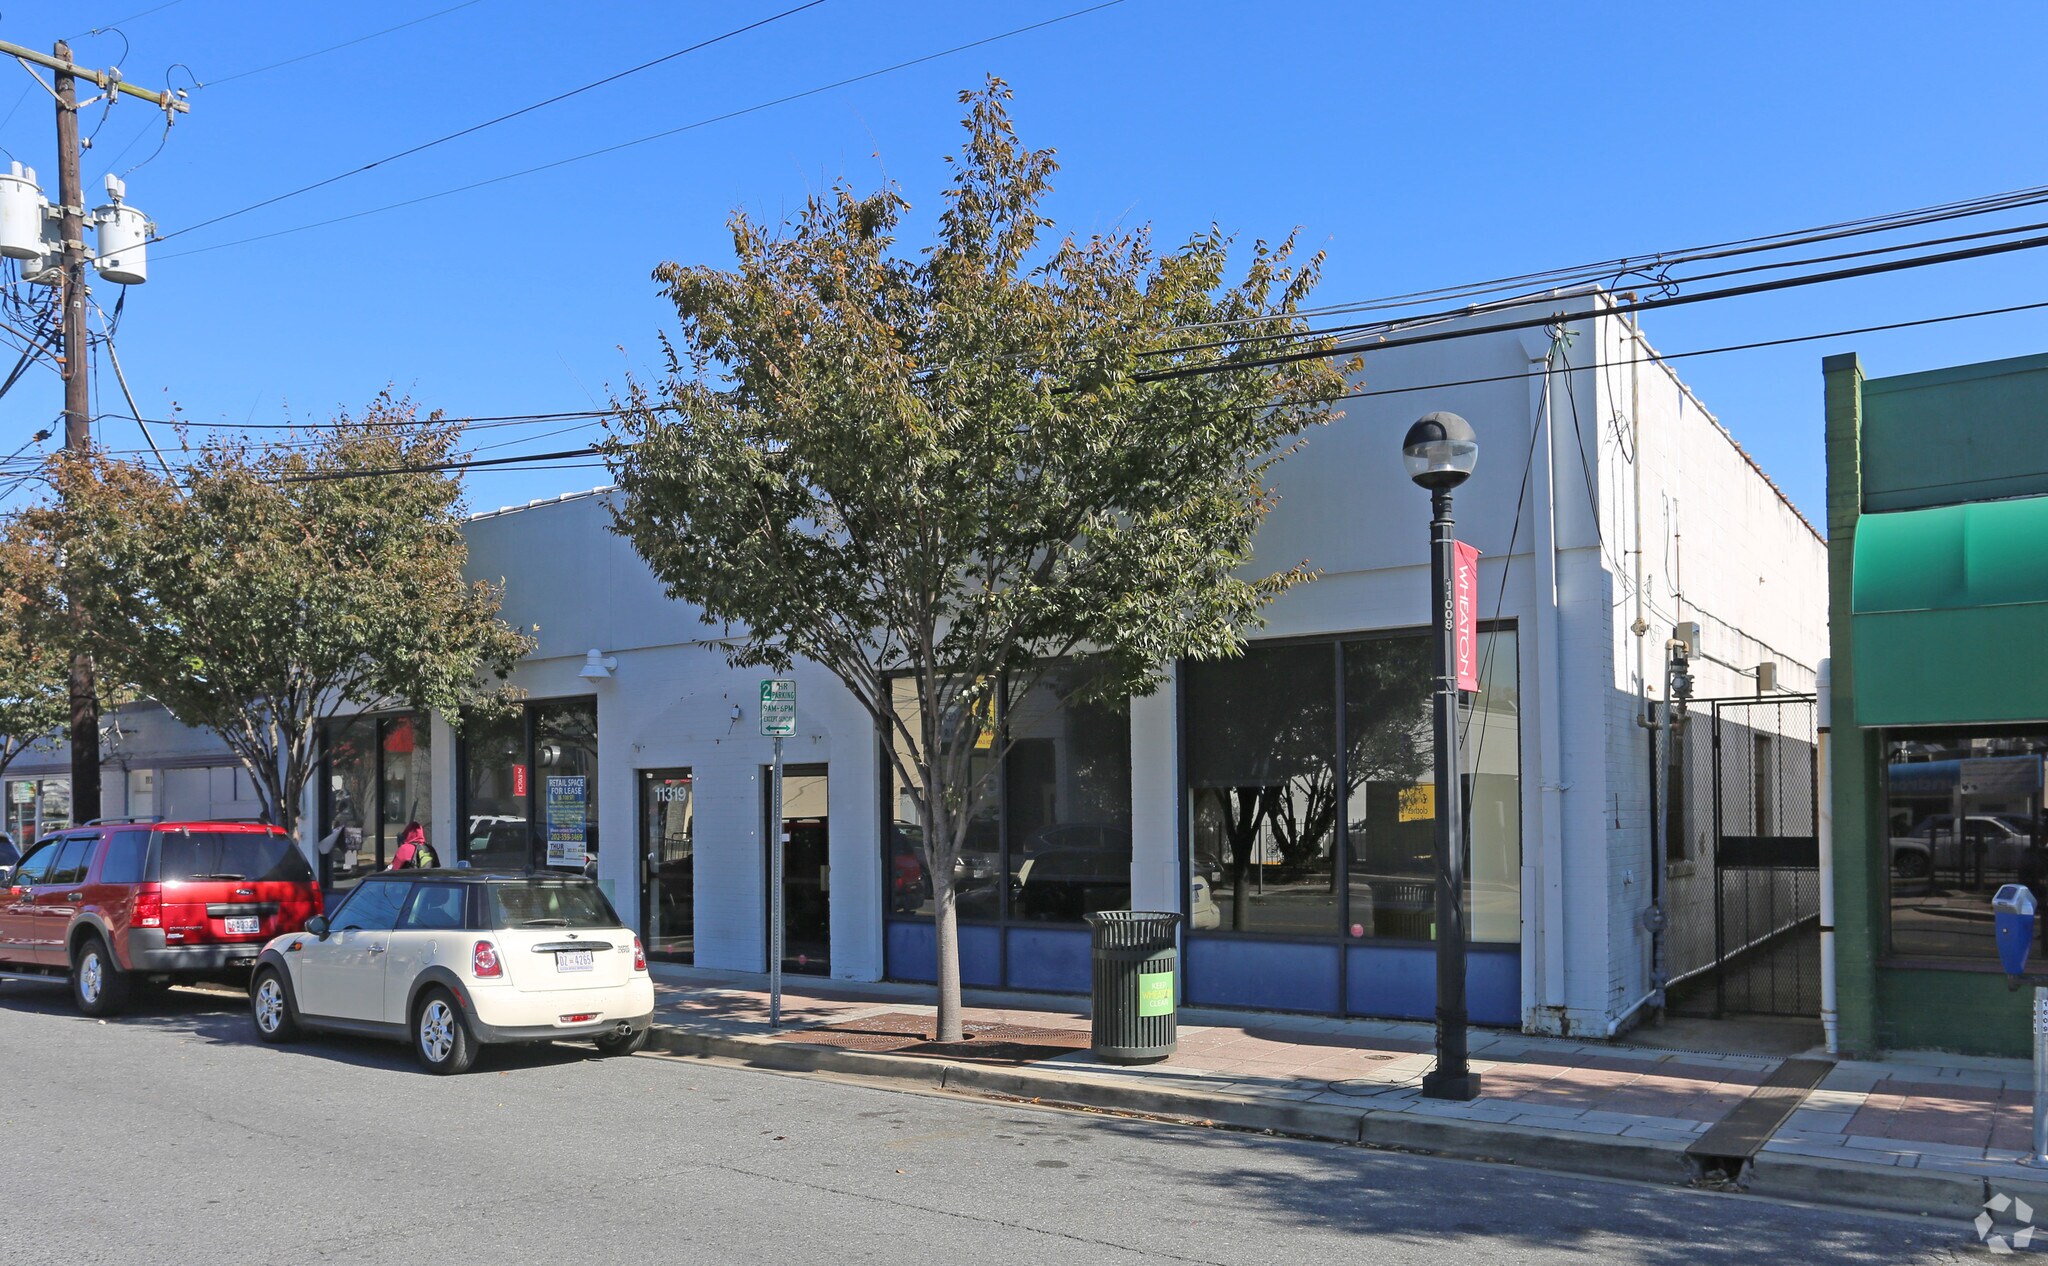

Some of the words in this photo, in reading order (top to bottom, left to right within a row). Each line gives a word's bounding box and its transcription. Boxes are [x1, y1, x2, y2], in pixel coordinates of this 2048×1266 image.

[1459, 565, 1470, 676] WHEATON
[762, 684, 771, 698] 2
[772, 691, 795, 699] PARKING
[549, 779, 567, 787] RETAIL
[568, 779, 584, 787] SPACE
[655, 786, 687, 802] 11319
[575, 955, 592, 966] 4265
